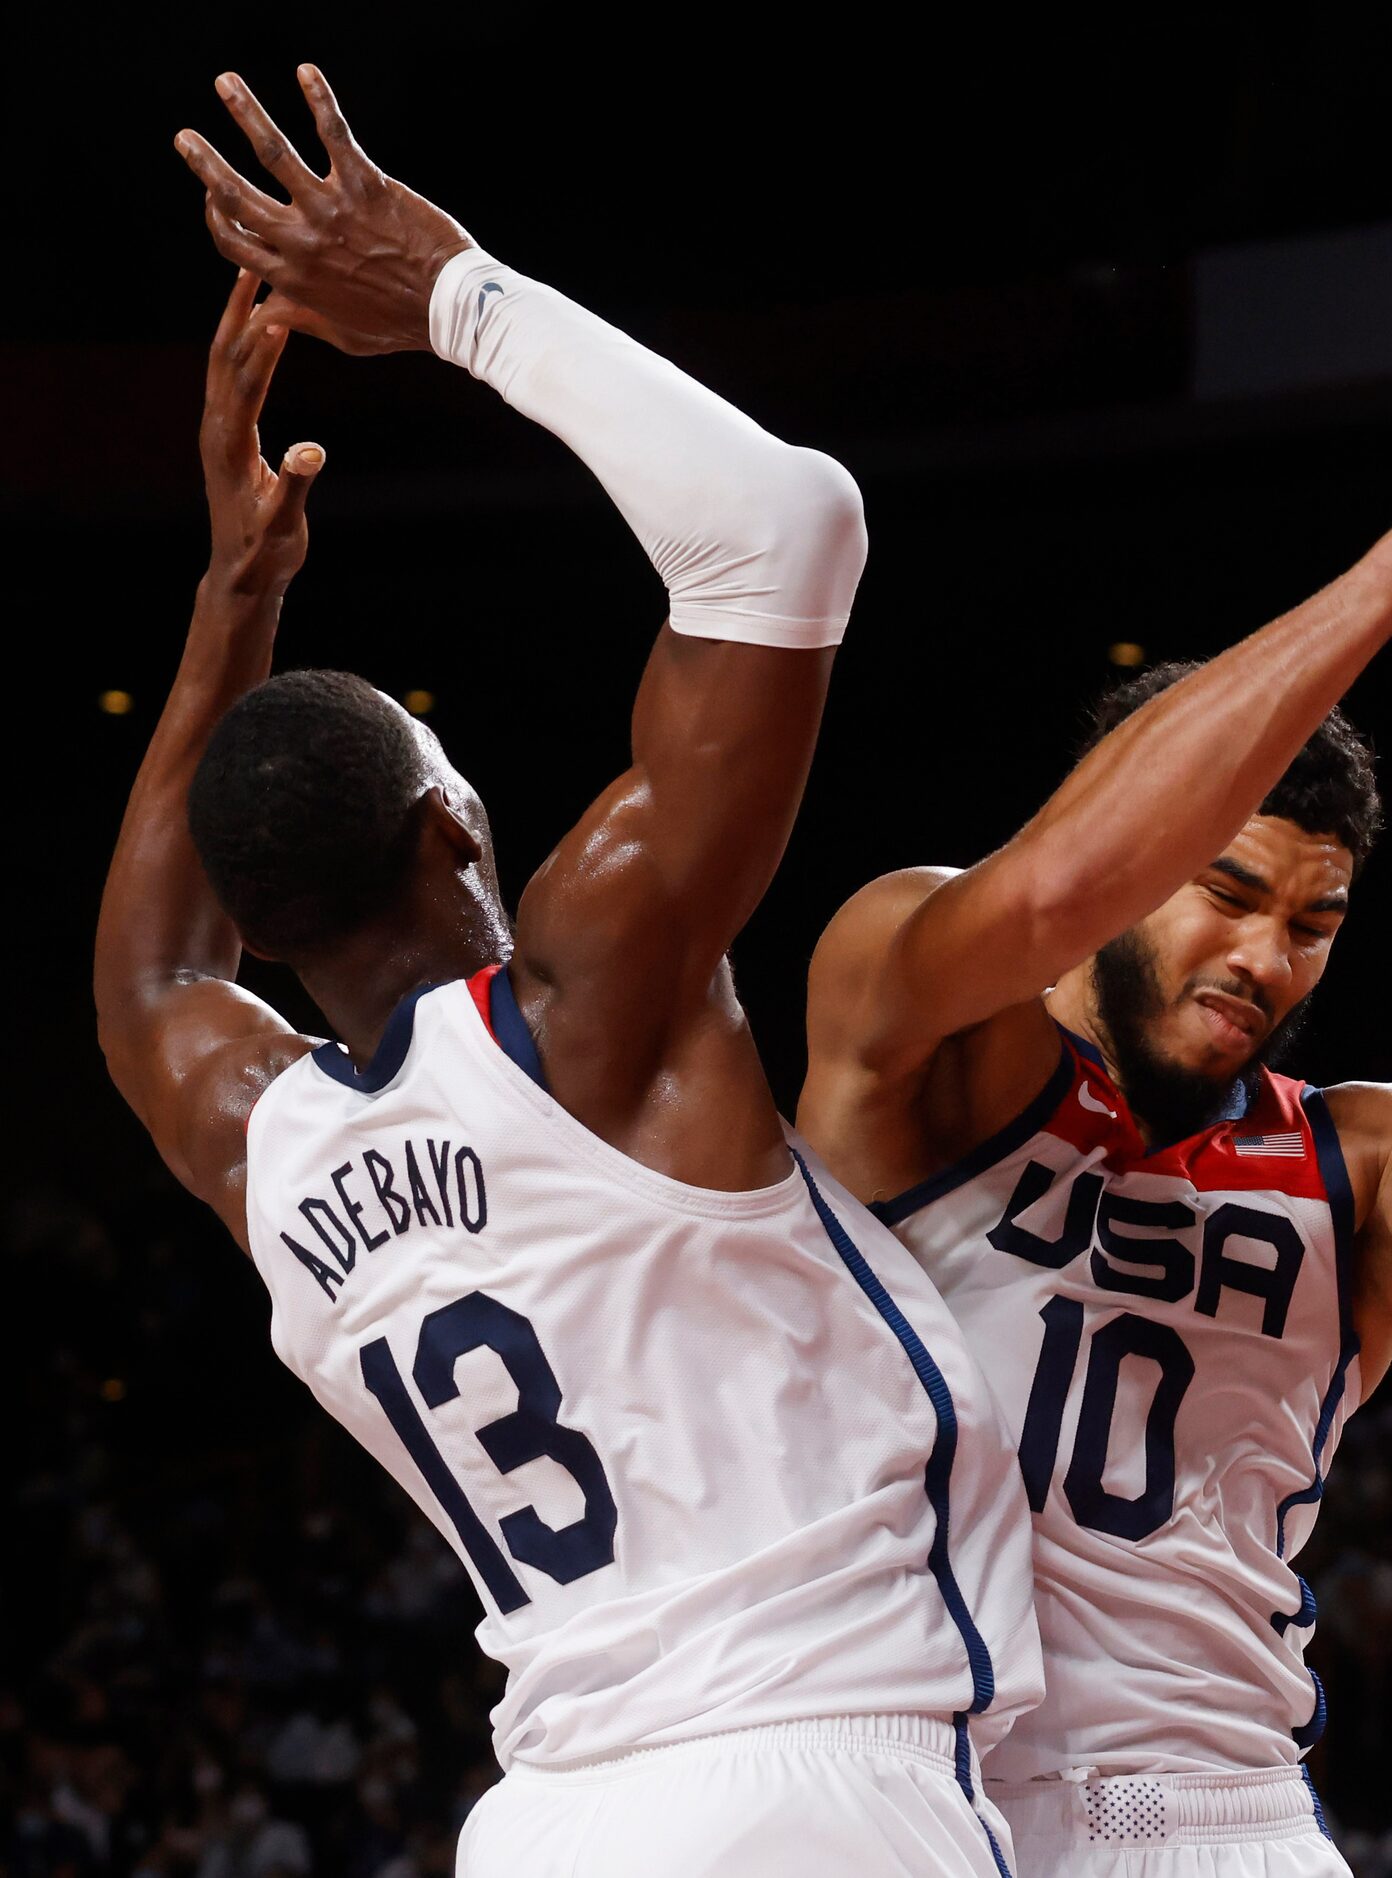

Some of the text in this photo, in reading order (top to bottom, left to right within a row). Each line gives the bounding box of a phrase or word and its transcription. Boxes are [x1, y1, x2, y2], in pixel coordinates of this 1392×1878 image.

[280, 1138, 488, 1304] ADEBAYO
[985, 1159, 1306, 1340] USA
[359, 1290, 619, 1616] 13
[1017, 1293, 1196, 1542] 10
